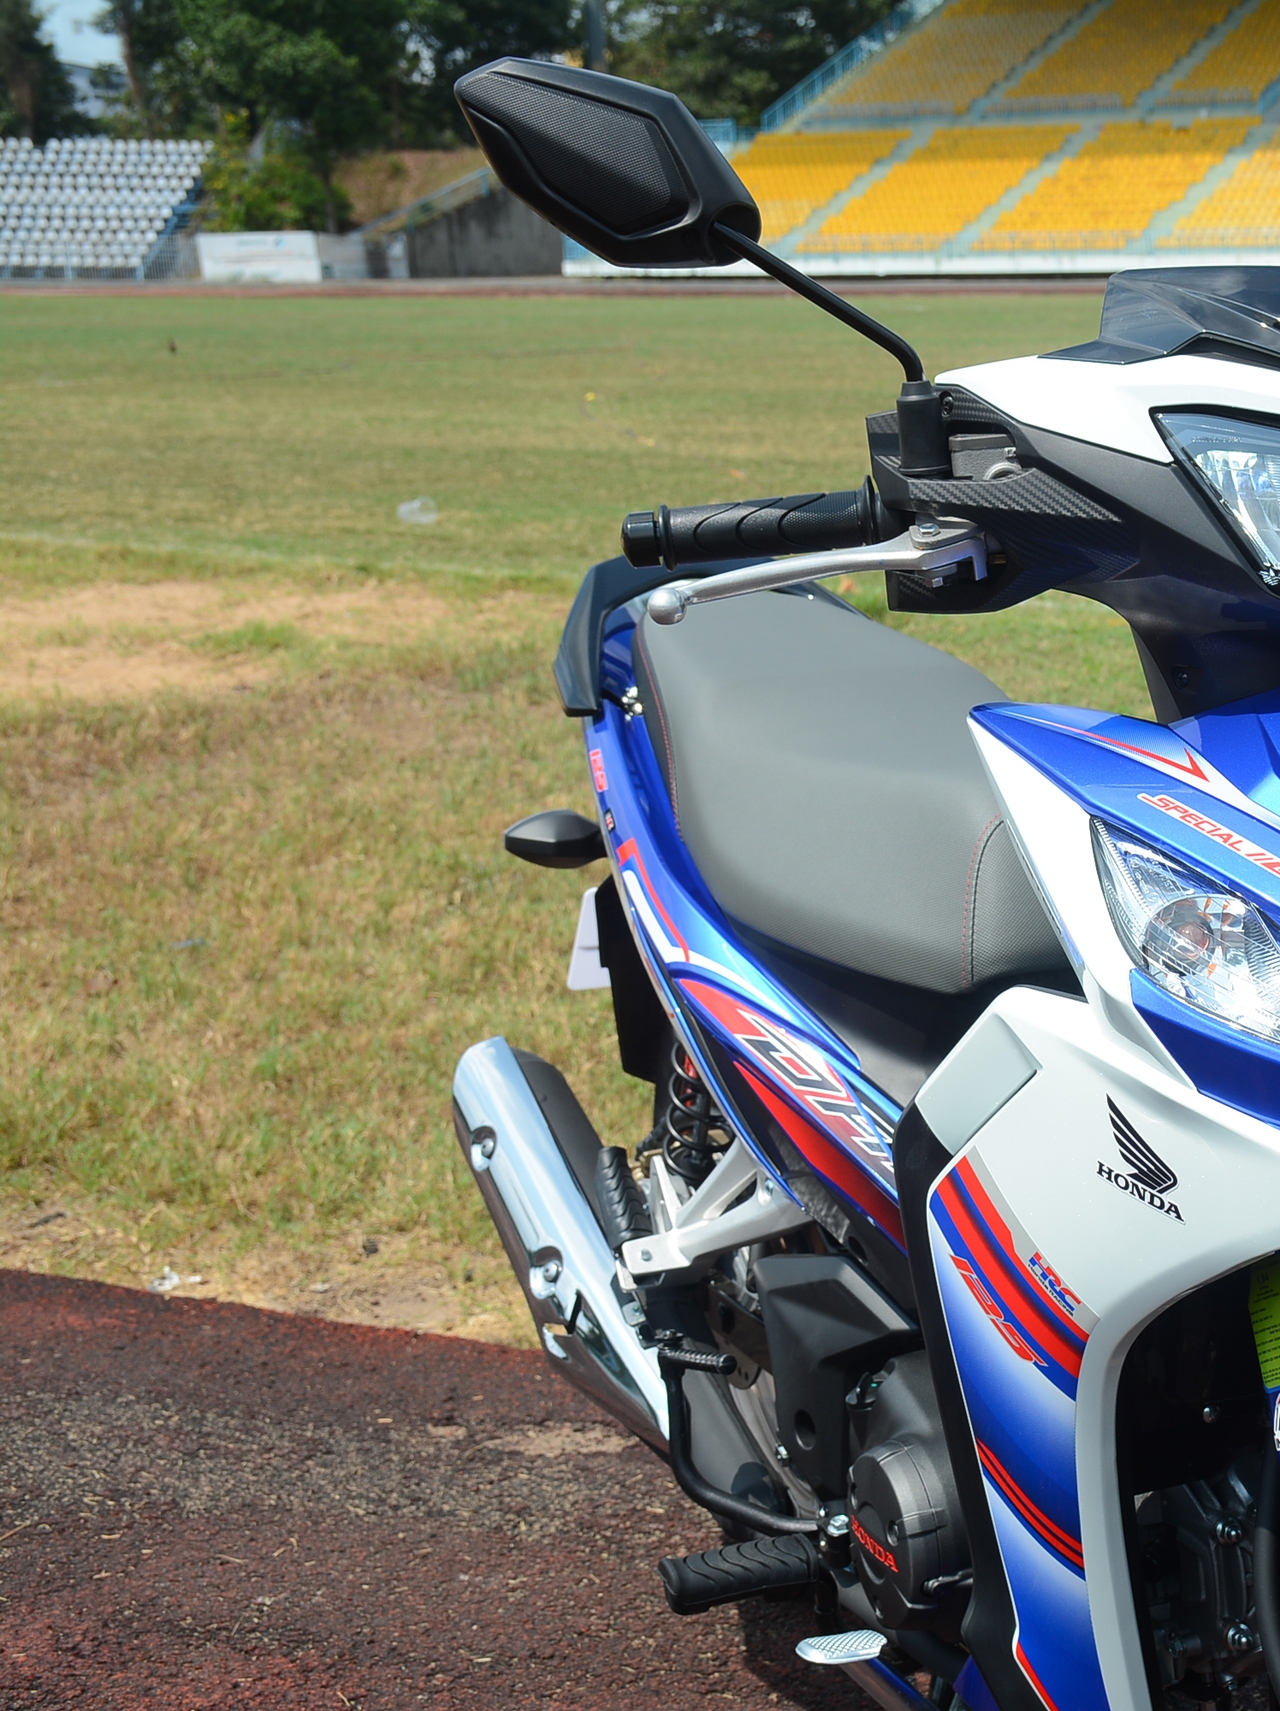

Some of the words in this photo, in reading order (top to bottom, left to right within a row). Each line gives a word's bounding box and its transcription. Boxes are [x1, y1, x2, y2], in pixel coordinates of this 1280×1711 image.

[1141, 796, 1243, 852] SPECIAL
[1096, 1160, 1185, 1222] HONDA
[1028, 1251, 1082, 1312] HRC
[851, 1515, 899, 1573] HONDA
